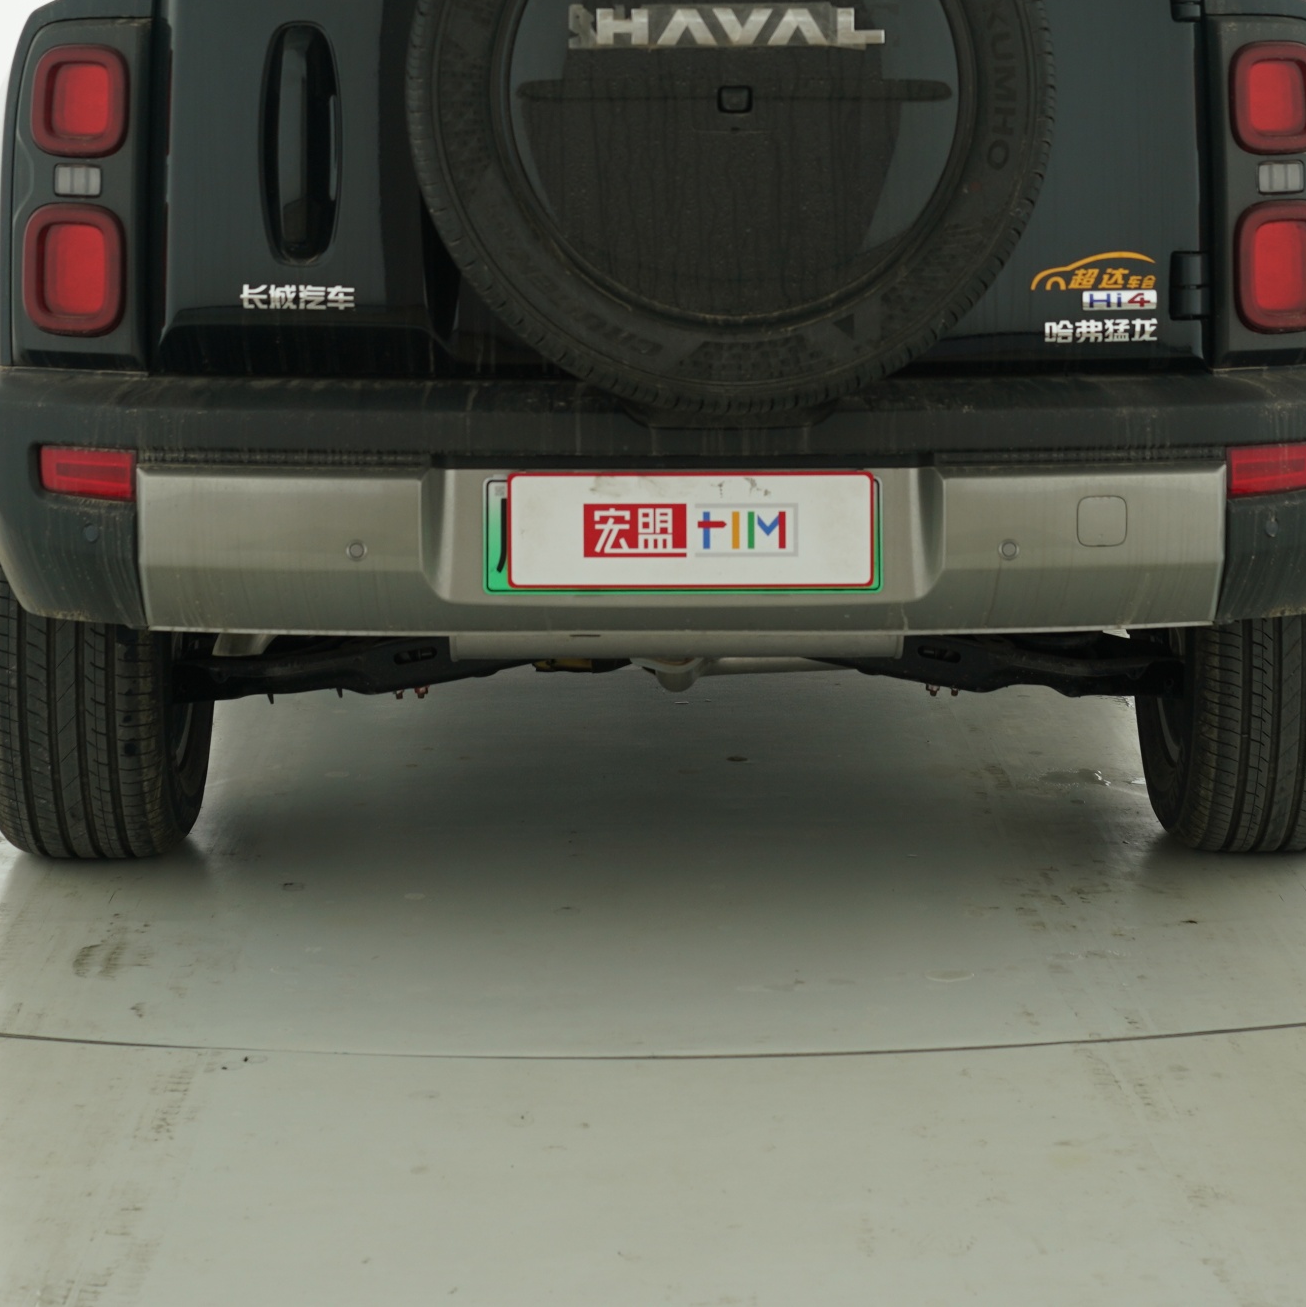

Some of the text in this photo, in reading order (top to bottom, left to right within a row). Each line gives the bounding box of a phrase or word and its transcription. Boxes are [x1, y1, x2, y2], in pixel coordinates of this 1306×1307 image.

[595, 7, 886, 45] HAVAL
[982, 0, 1018, 172] KUMHO
[240, 284, 355, 310] 长城汽车
[1088, 293, 1151, 308] Hi4
[1044, 318, 1158, 344] 哈弗猛龙
[594, 507, 687, 554] 宏盟
